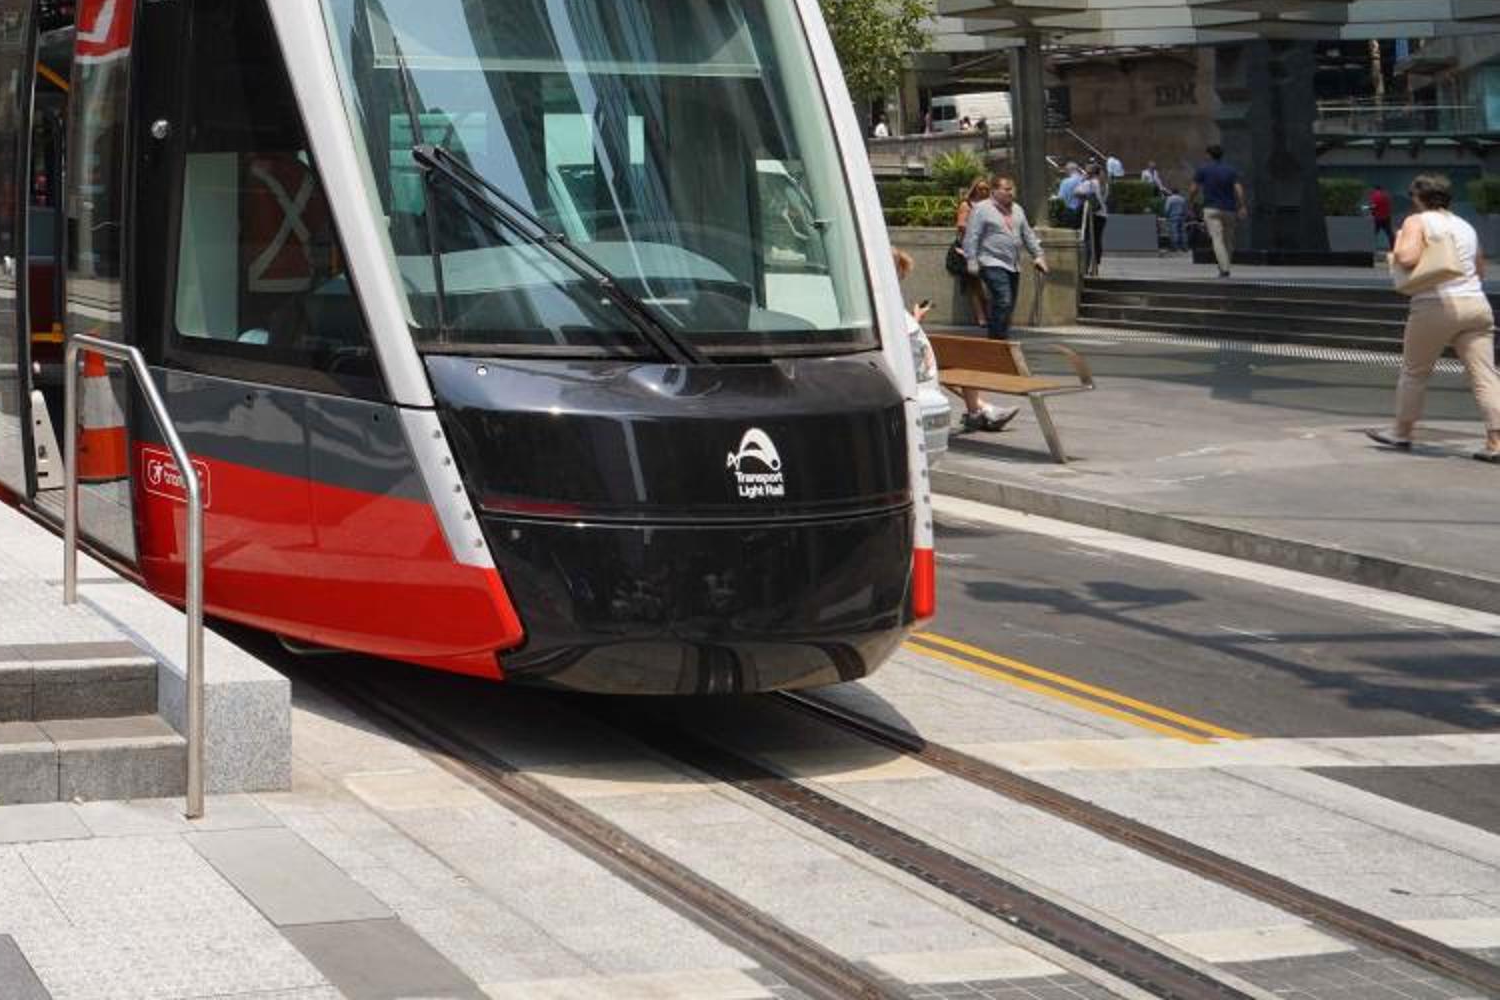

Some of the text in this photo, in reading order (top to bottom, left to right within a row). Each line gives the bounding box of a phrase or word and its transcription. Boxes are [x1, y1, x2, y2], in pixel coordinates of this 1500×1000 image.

[735, 471, 783, 484] Transport
[739, 484, 784, 498] Light Rail
